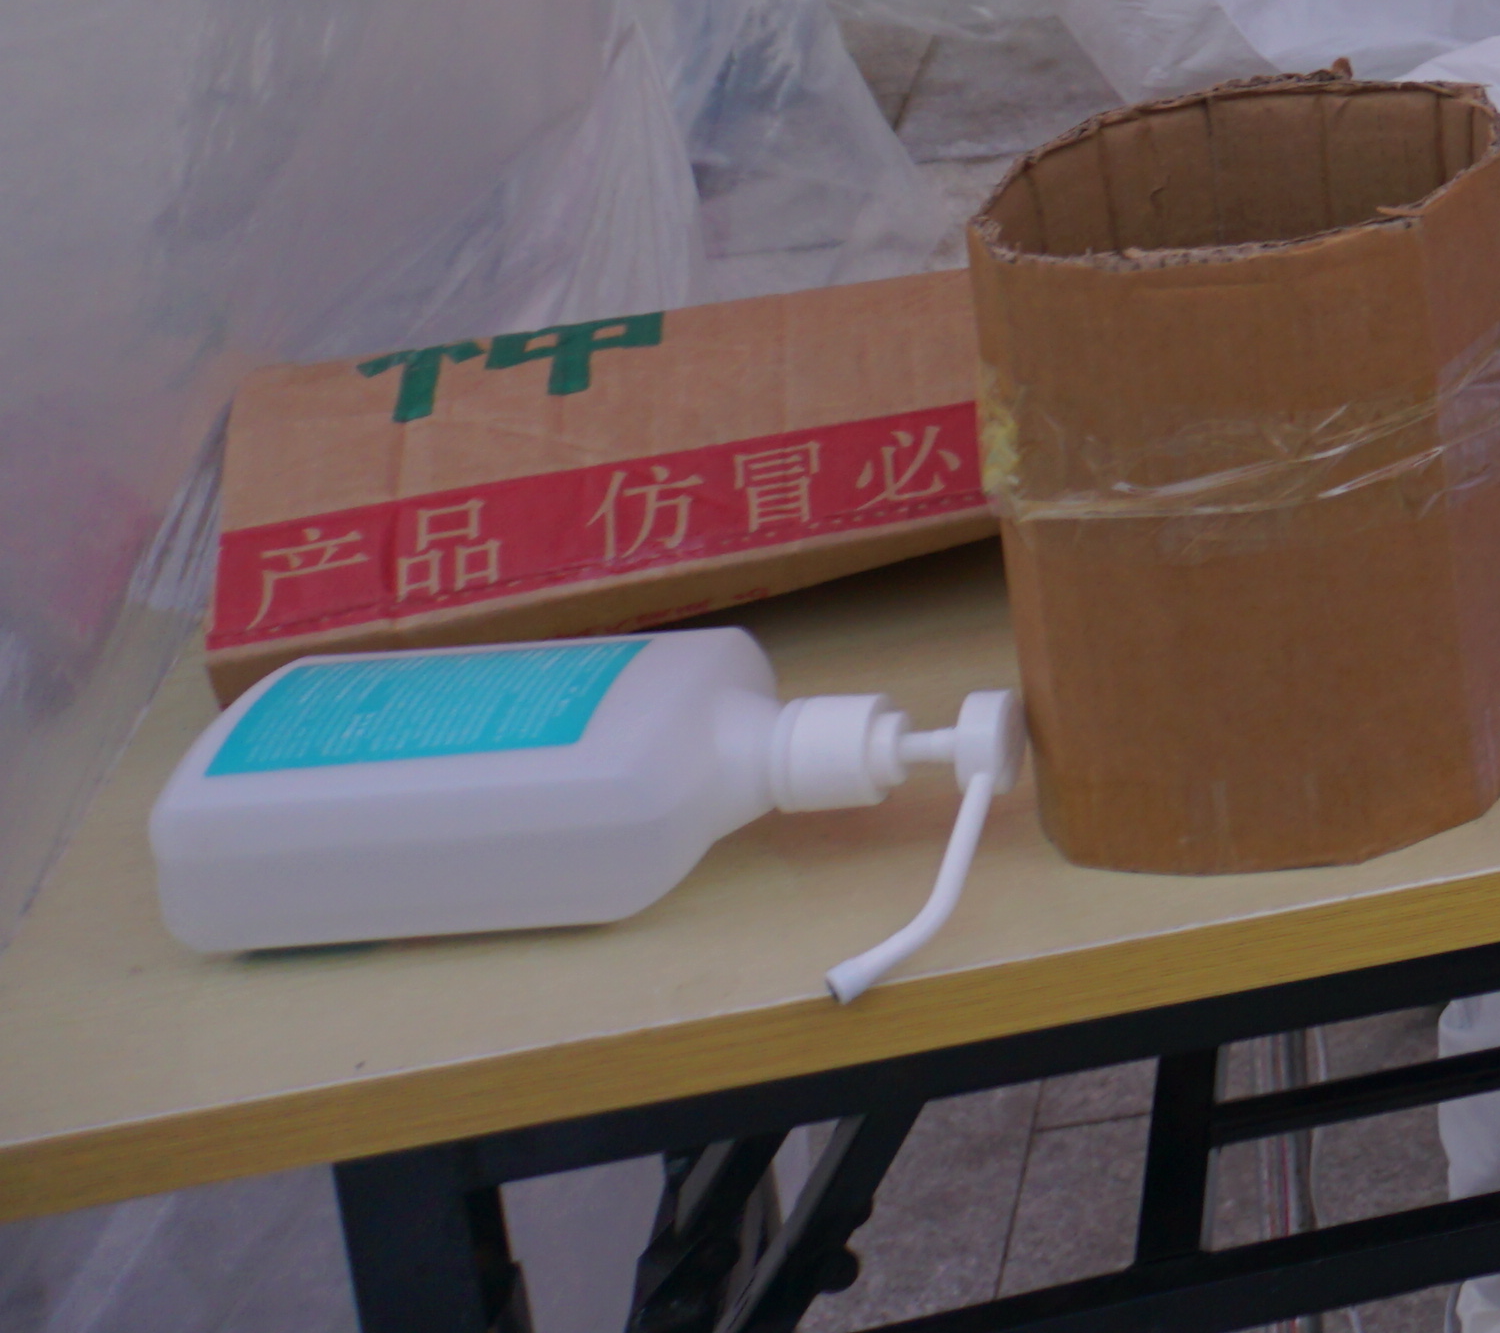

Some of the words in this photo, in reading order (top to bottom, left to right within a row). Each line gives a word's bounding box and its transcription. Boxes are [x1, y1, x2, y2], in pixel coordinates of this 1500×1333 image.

[250, 498, 501, 626] 产品
[586, 425, 962, 558] 仿冒必
